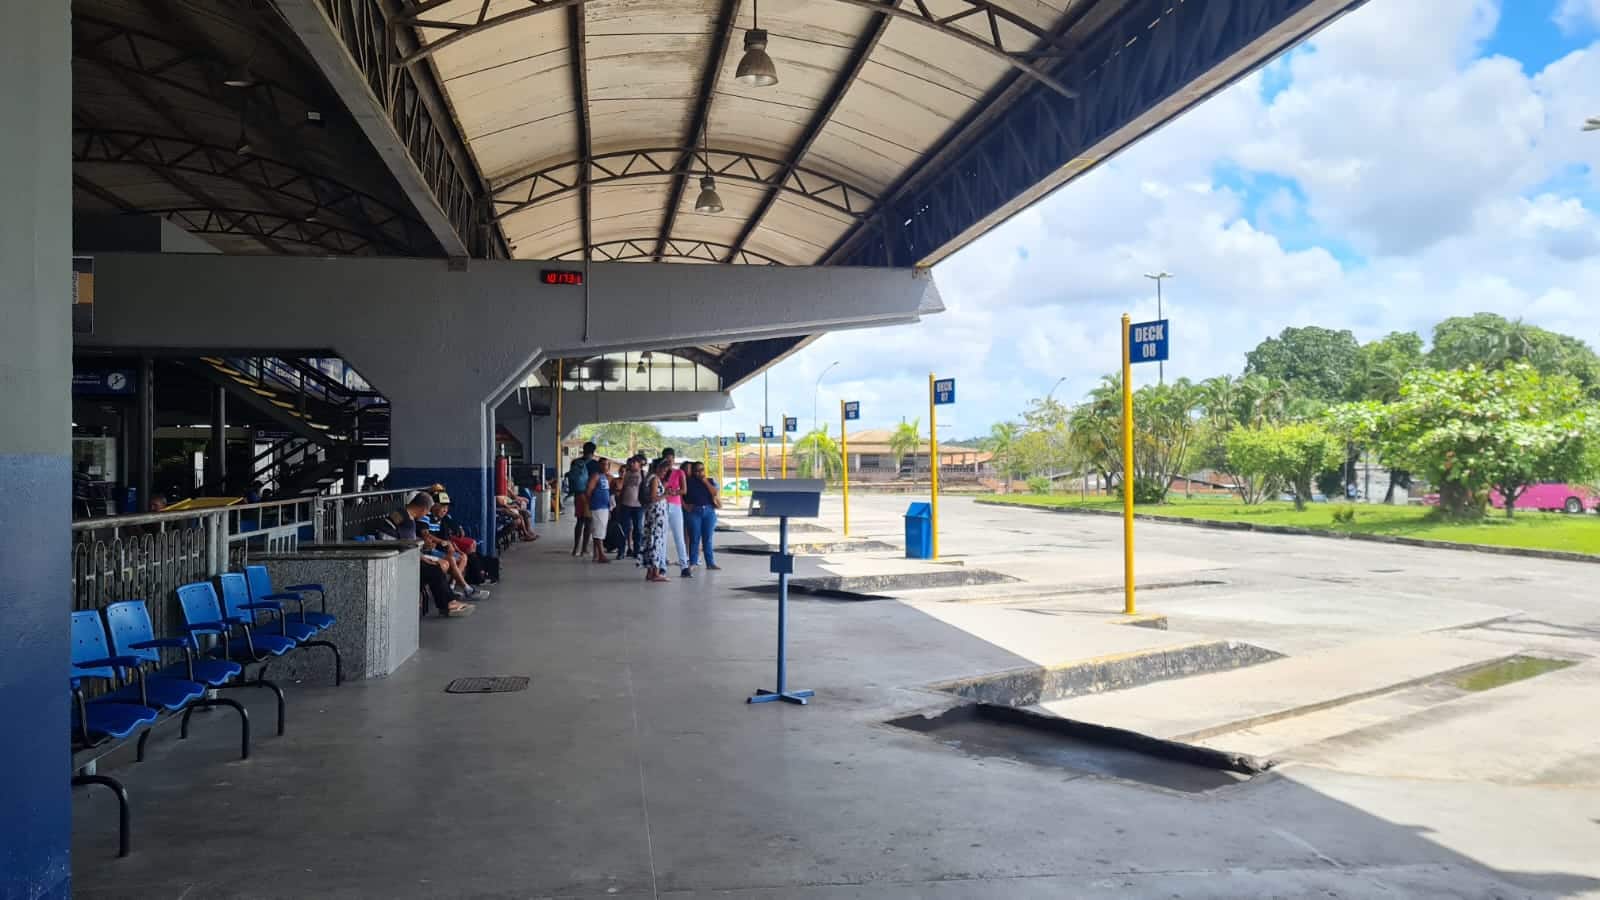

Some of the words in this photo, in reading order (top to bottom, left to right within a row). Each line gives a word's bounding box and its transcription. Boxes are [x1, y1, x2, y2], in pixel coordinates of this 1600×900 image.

[1135, 325, 1164, 343] DECK
[1142, 343, 1156, 358] 08
[936, 381, 953, 392] DECK
